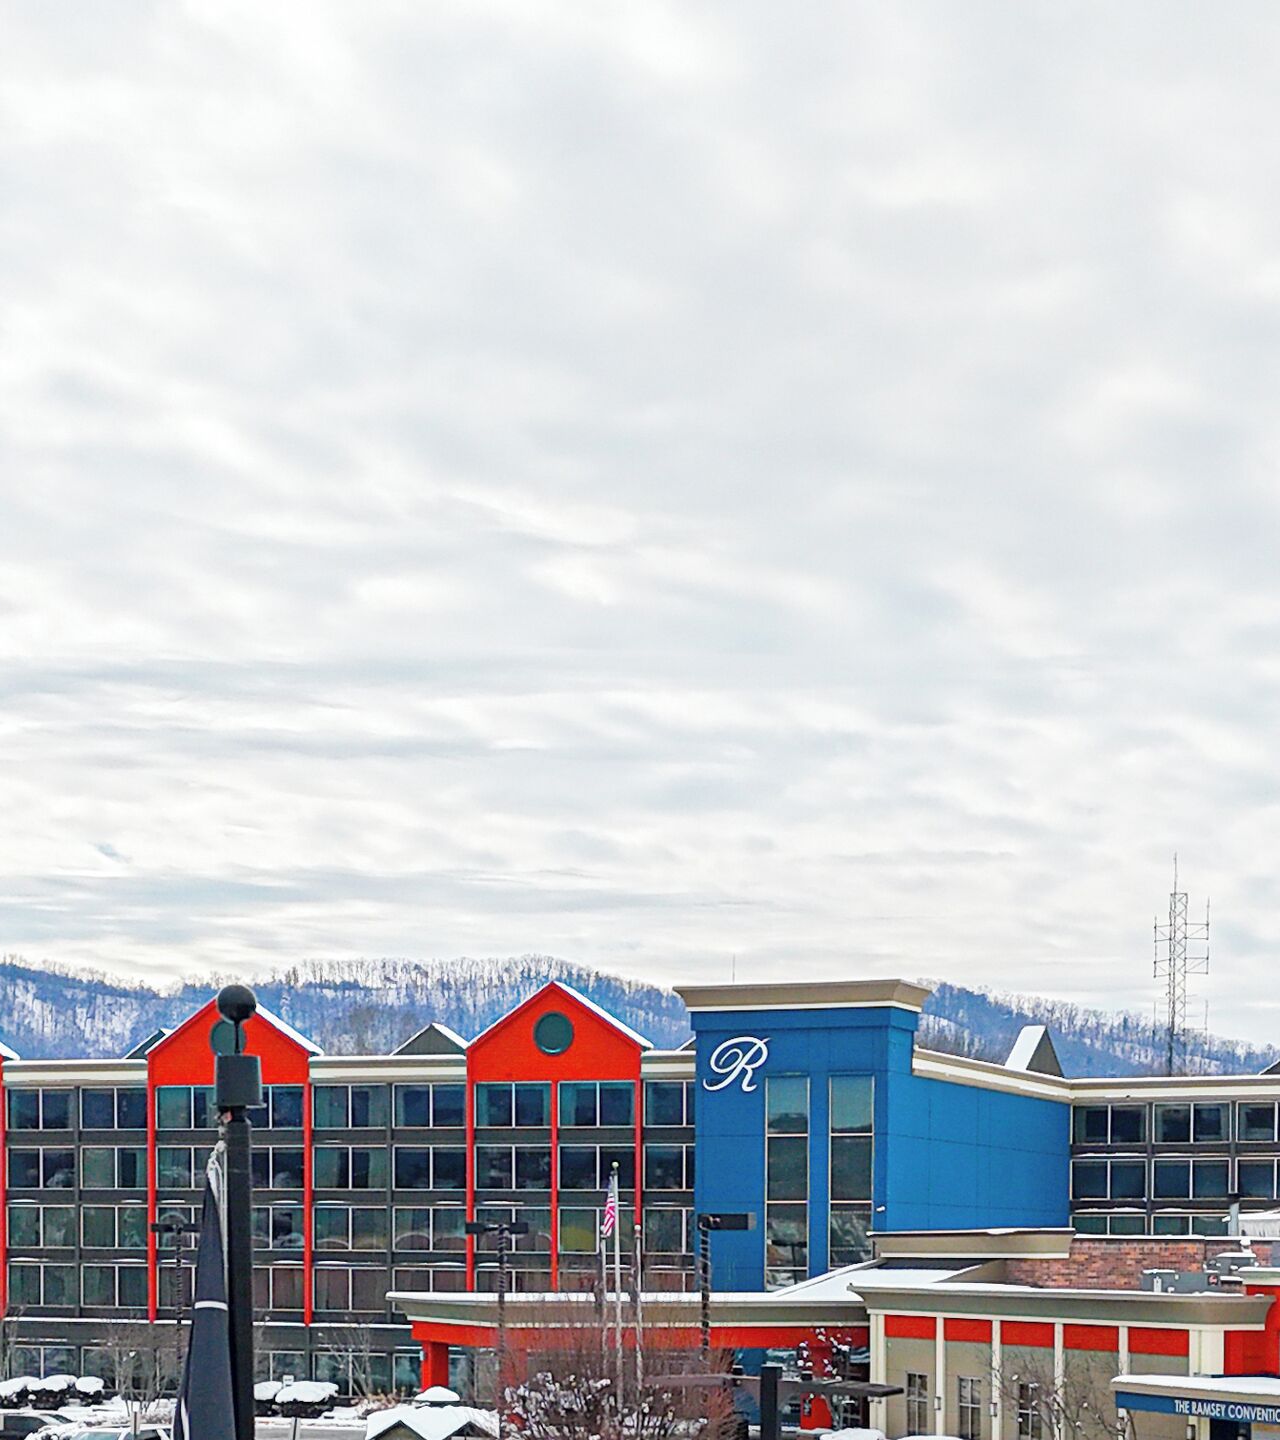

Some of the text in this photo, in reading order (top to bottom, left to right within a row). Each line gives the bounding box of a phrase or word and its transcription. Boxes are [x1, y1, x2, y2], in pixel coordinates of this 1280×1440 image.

[703, 1036, 771, 1092] R
[1174, 1399, 1190, 1414] THE
[1191, 1401, 1226, 1417] RAMSEY
